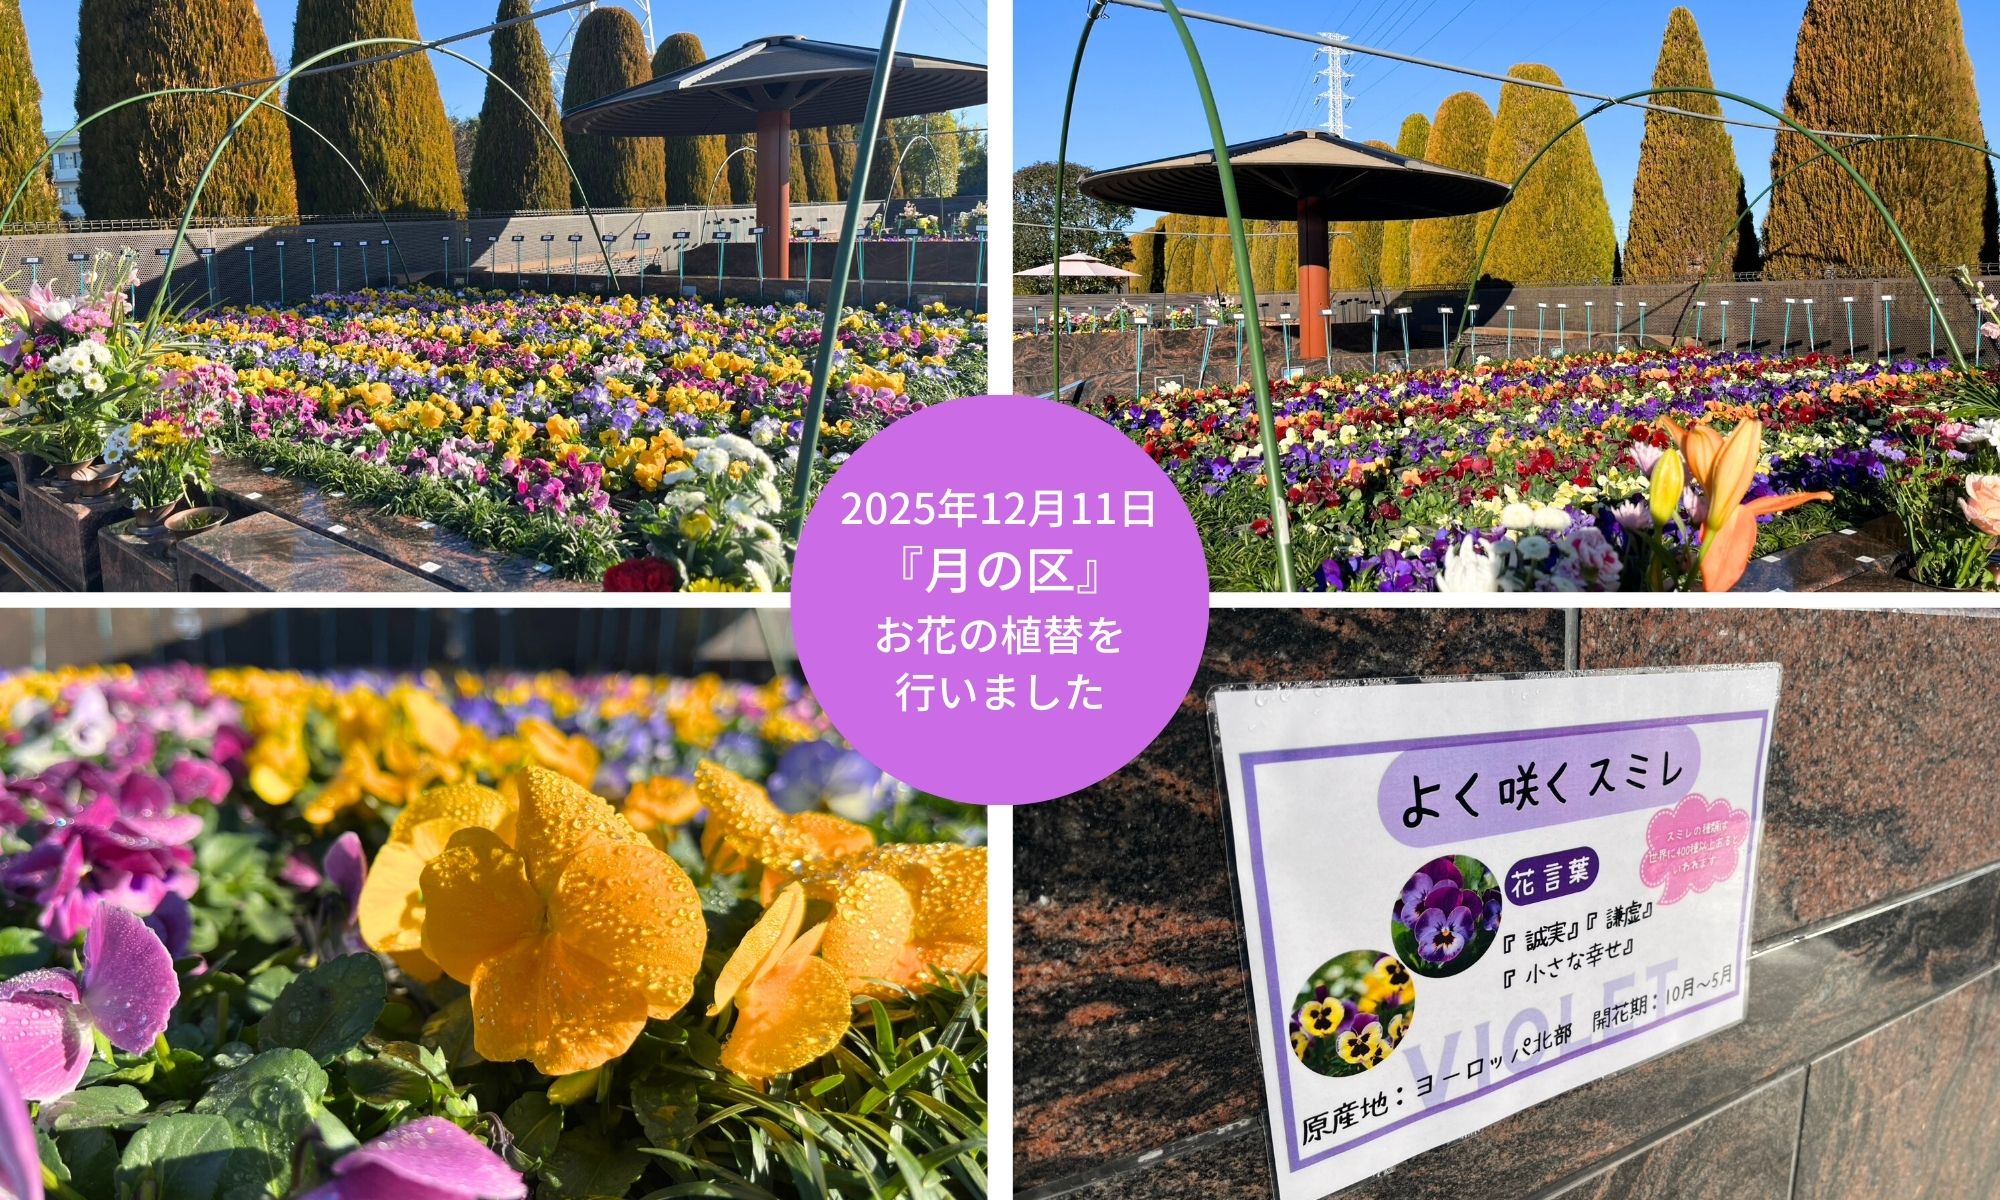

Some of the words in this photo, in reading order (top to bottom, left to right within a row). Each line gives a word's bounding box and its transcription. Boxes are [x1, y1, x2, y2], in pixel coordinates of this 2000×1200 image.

[1666, 820, 1729, 843] スミレの種類は
[1511, 856, 1591, 898] 花言葉
[1672, 855, 1717, 876] いわれます
[1402, 958, 1679, 1111] VIOLET
